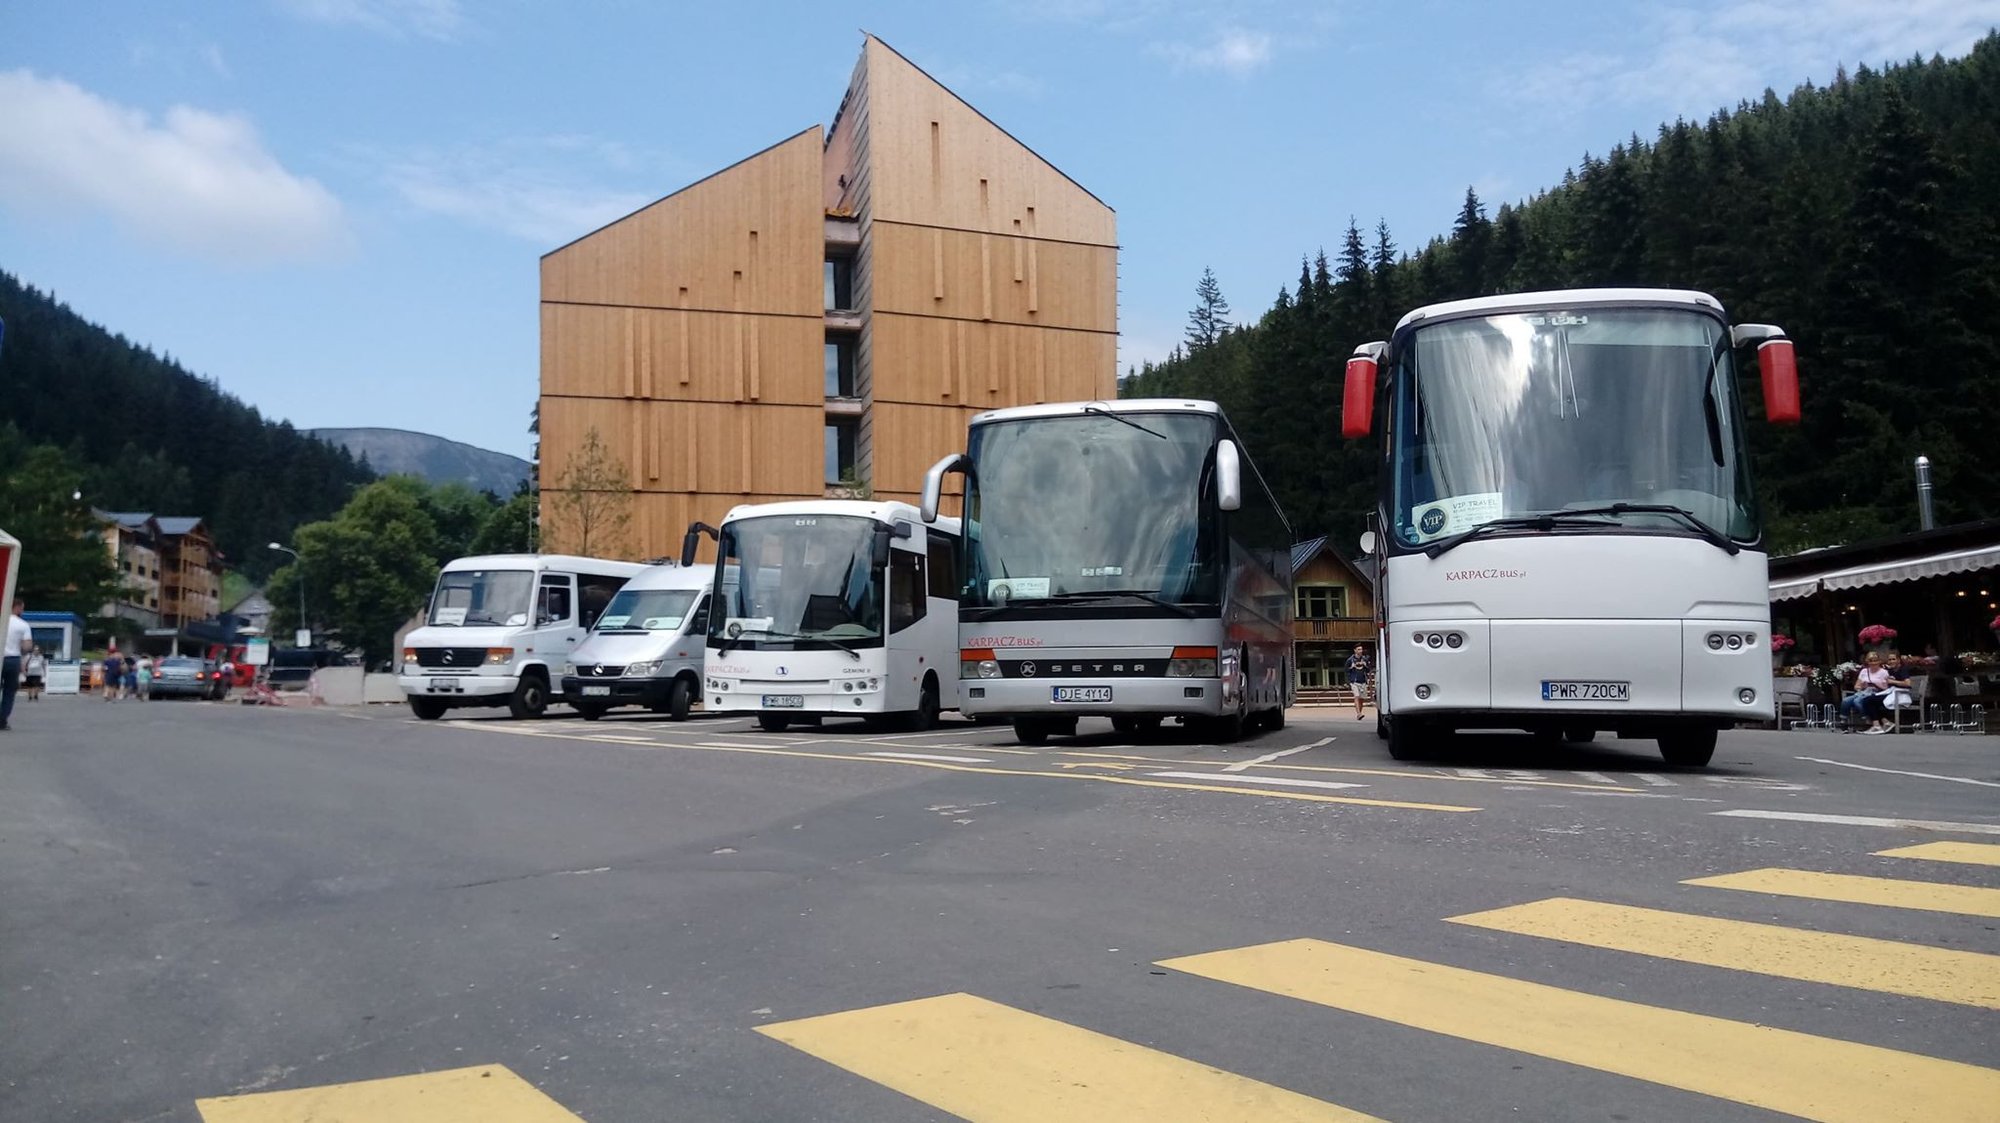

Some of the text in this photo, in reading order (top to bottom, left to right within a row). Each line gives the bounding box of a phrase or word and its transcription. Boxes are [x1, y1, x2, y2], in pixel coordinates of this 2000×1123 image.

[1452, 502, 1466, 510] VIP
[1469, 499, 1496, 507] TRAVEL
[1423, 515, 1443, 527] VIP
[1446, 569, 1498, 581] KARPACZ
[967, 636, 1016, 647] KARPACZ
[1051, 664, 1145, 672] SETRA
[1060, 688, 1109, 699] DJE 4Y14
[1550, 684, 1627, 698] PWR 720CM
